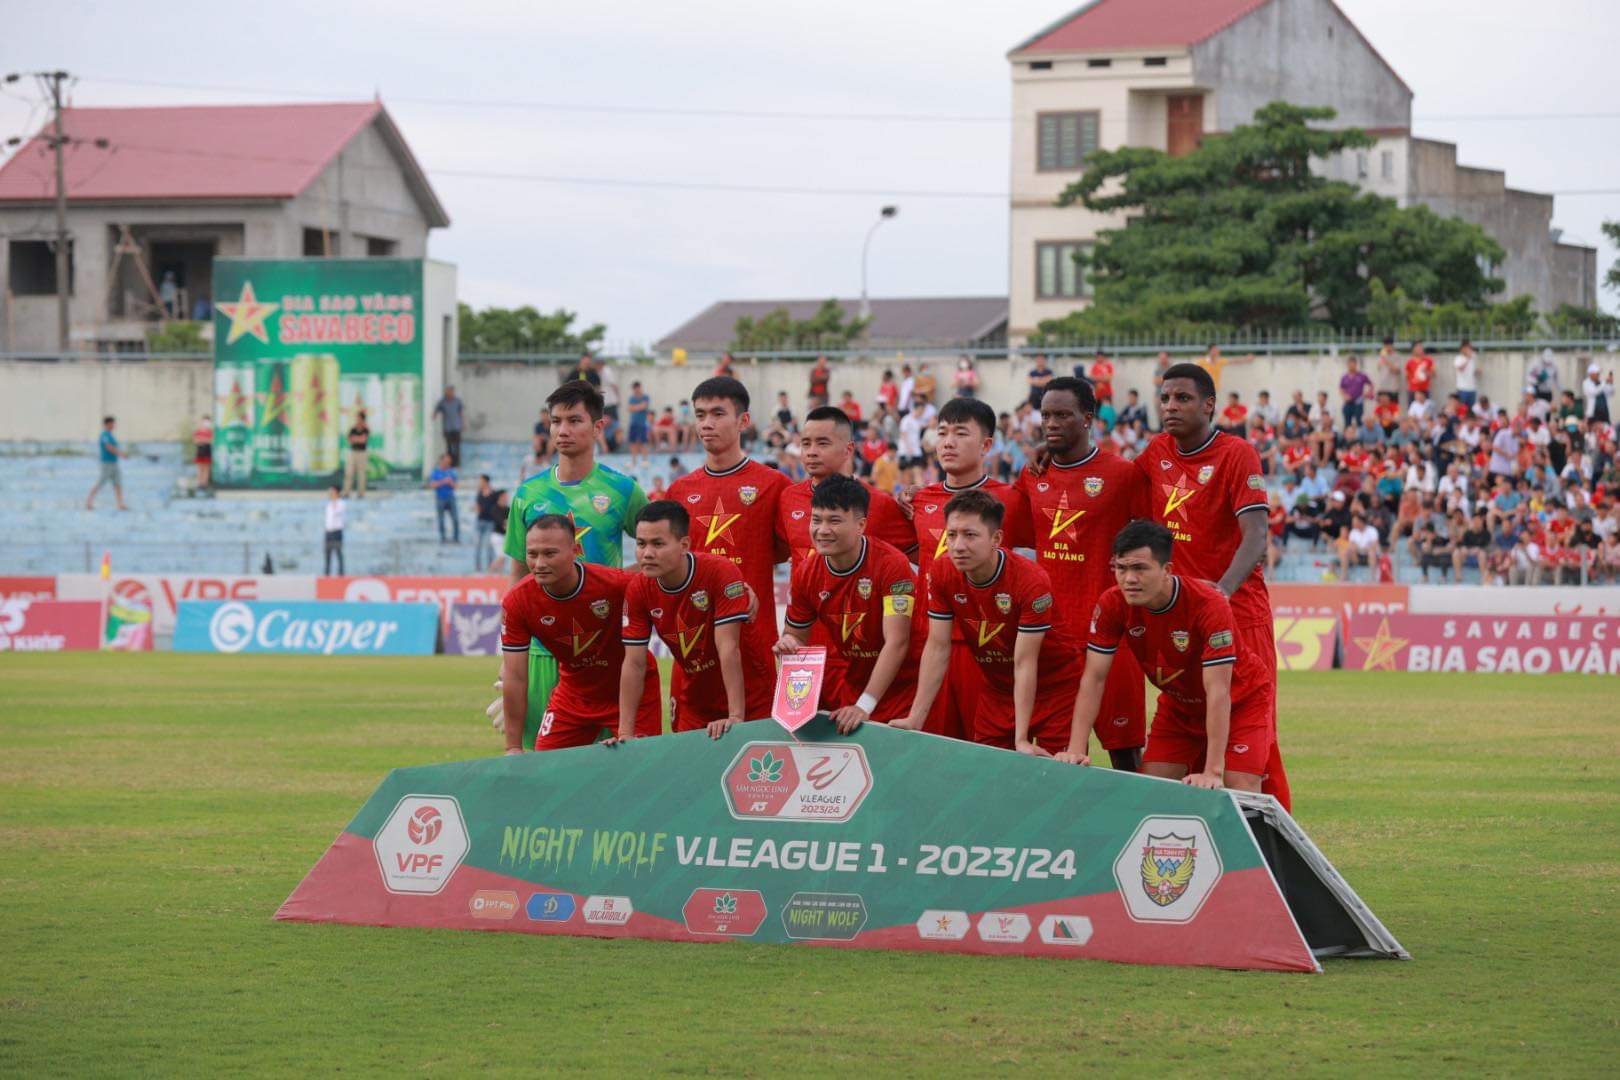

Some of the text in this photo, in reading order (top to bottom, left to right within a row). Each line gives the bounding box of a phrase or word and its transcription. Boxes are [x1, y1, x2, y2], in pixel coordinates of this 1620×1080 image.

[284, 295, 314, 310] BIA
[320, 295, 356, 310] SAO
[280, 314, 415, 344] SAVABECO
[1167, 521, 1180, 529] BIA
[1054, 542, 1069, 551] BIA
[256, 610, 398, 656] Casper
[1442, 621, 1620, 640] SAVABEC
[1407, 645, 1467, 673] BIA
[1475, 646, 1552, 673] SAO
[800, 794, 841, 804] V.LEAGUE
[800, 804, 840, 814] 2023/24
[396, 852, 445, 873] VPF
[501, 825, 584, 870] NIGHT
[591, 829, 667, 876] WOLF
[675, 836, 860, 873] V.LEAGUE
[866, 843, 888, 873] 1
[915, 844, 1077, 882] 2023/24
[790, 909, 860, 927] NIGHT WOLF
